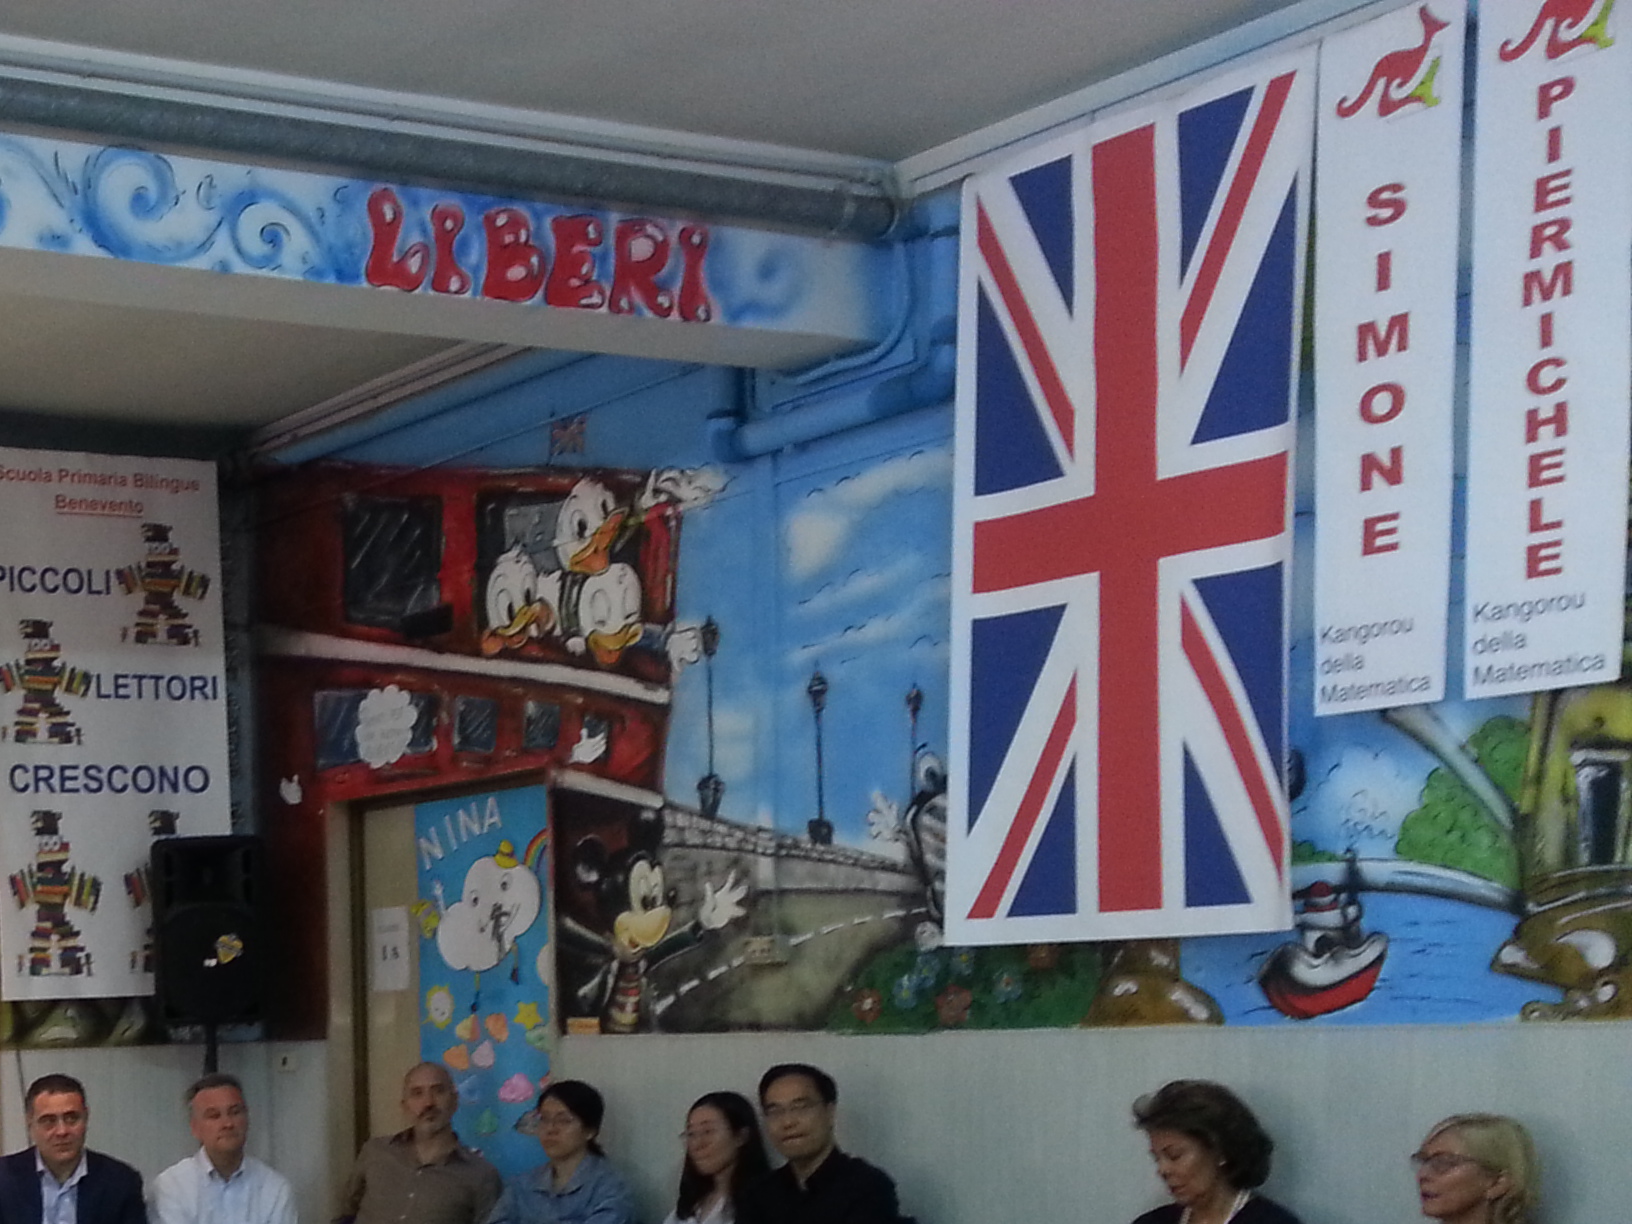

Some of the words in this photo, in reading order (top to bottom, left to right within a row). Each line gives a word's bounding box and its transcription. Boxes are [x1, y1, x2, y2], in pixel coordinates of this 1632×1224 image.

[364, 185, 713, 323] LIBERI
[1521, 76, 1577, 580] PIERMICHELE
[1357, 182, 1410, 556] SIMONE
[57, 469, 128, 488] Primaria
[133, 472, 200, 494] Bilingue
[54, 494, 144, 514] Benevento
[1472, 592, 1587, 624] Kangorou
[1320, 616, 1415, 646] Kangorou
[1472, 629, 1529, 655] della
[1320, 654, 1366, 676] della
[1472, 652, 1608, 686] Matematica
[96, 673, 218, 700] LETTORI
[1320, 674, 1433, 704] Matematica
[9, 763, 210, 794] CRESCONO
[418, 796, 502, 871] NINA
